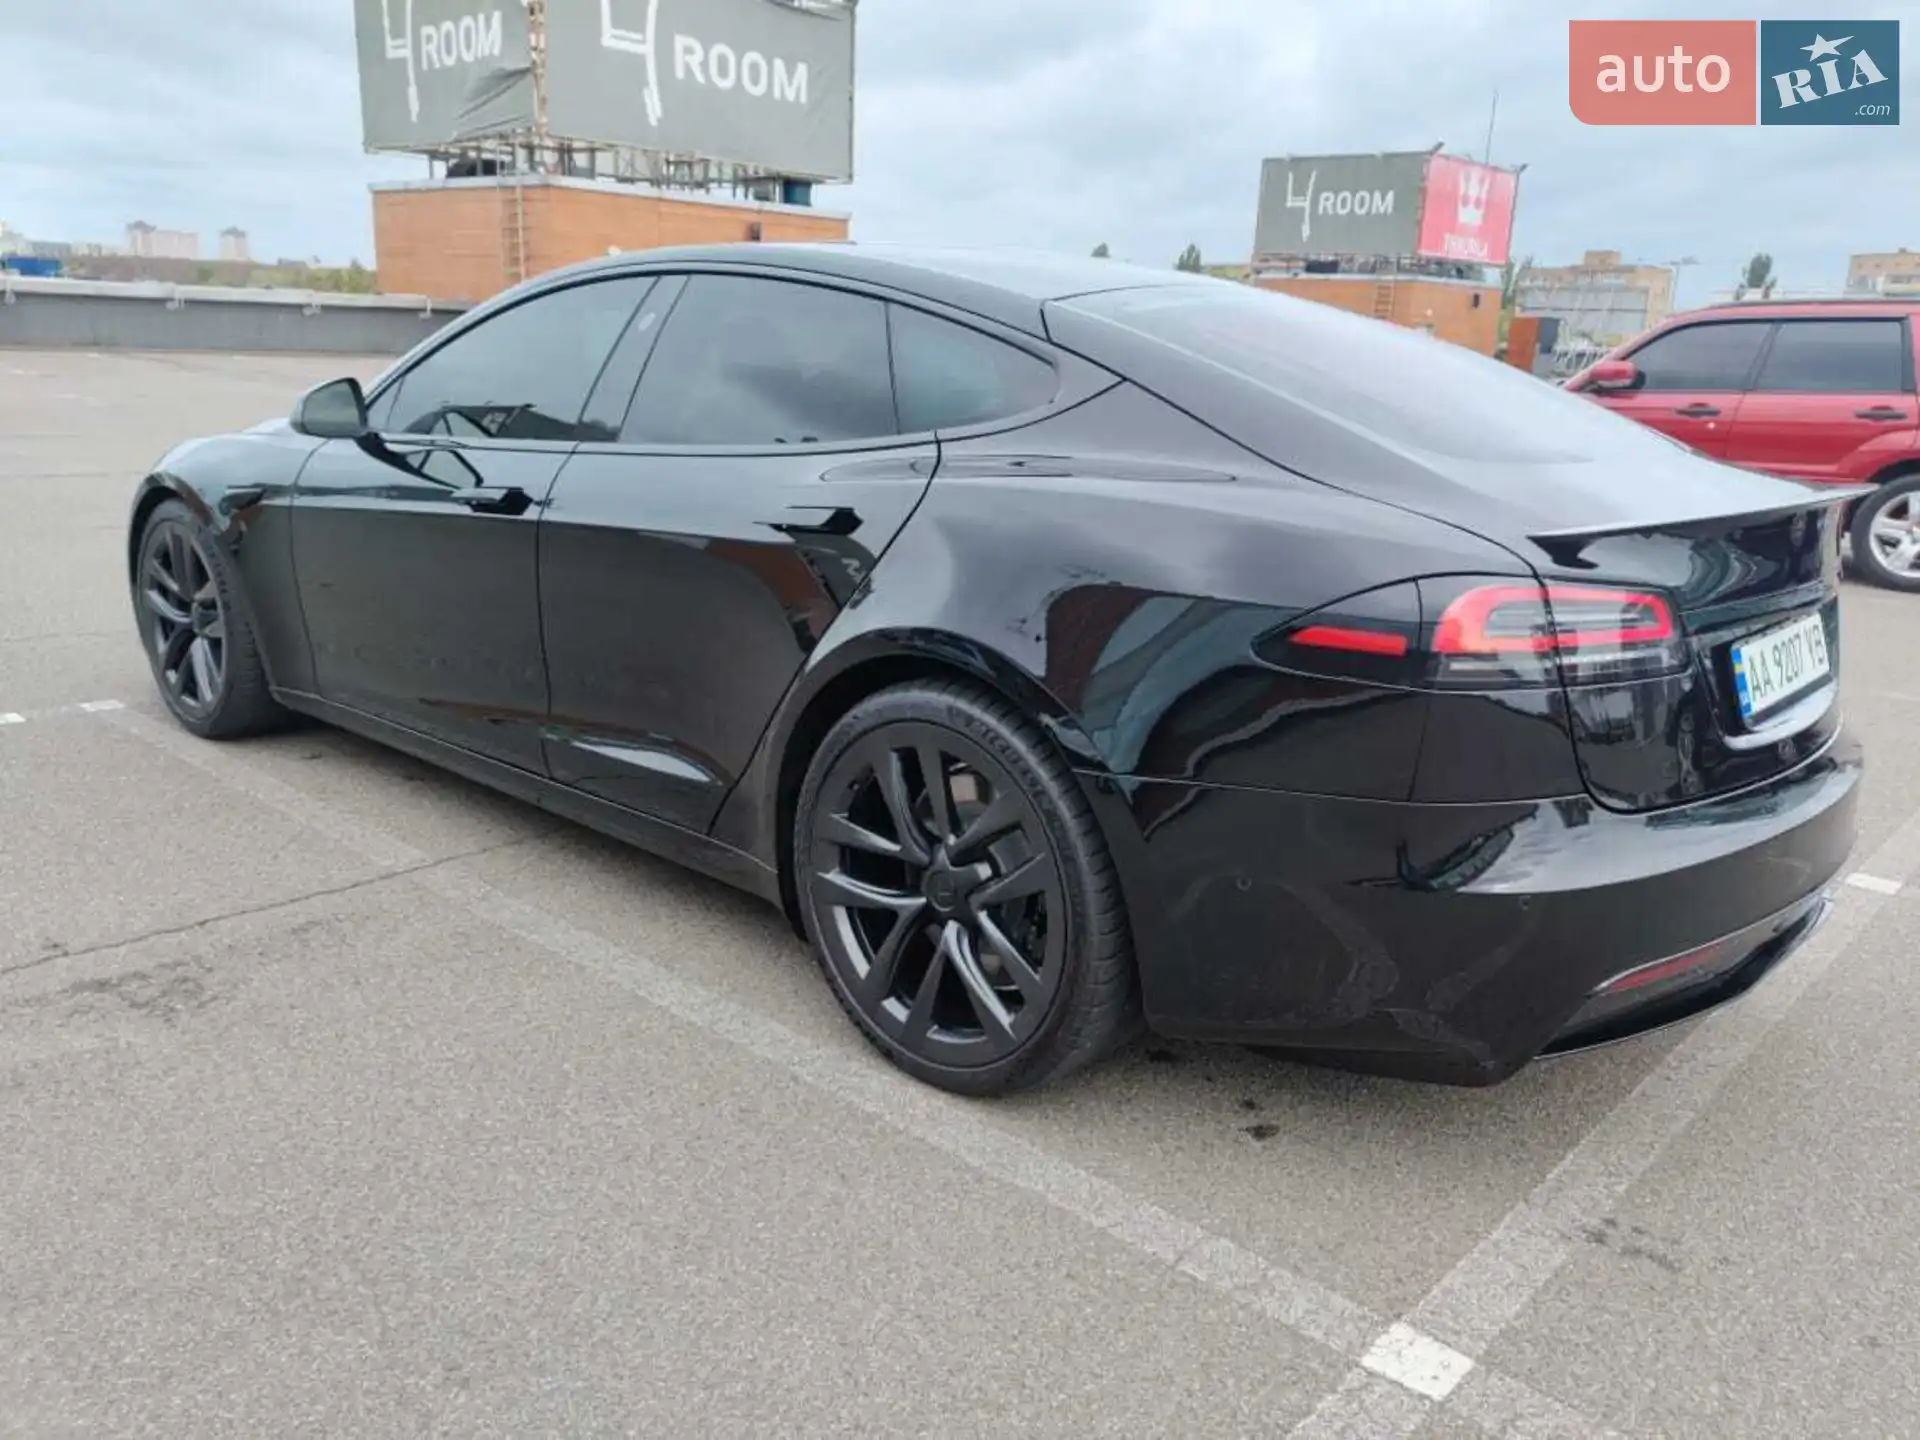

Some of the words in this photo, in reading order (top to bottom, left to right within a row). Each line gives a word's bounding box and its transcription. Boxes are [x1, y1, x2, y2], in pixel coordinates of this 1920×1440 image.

[420, 10, 503, 71] ROOM
[674, 32, 808, 105] ROOM
[1318, 189, 1395, 216] ROOM
[1748, 649, 1775, 702] AA
